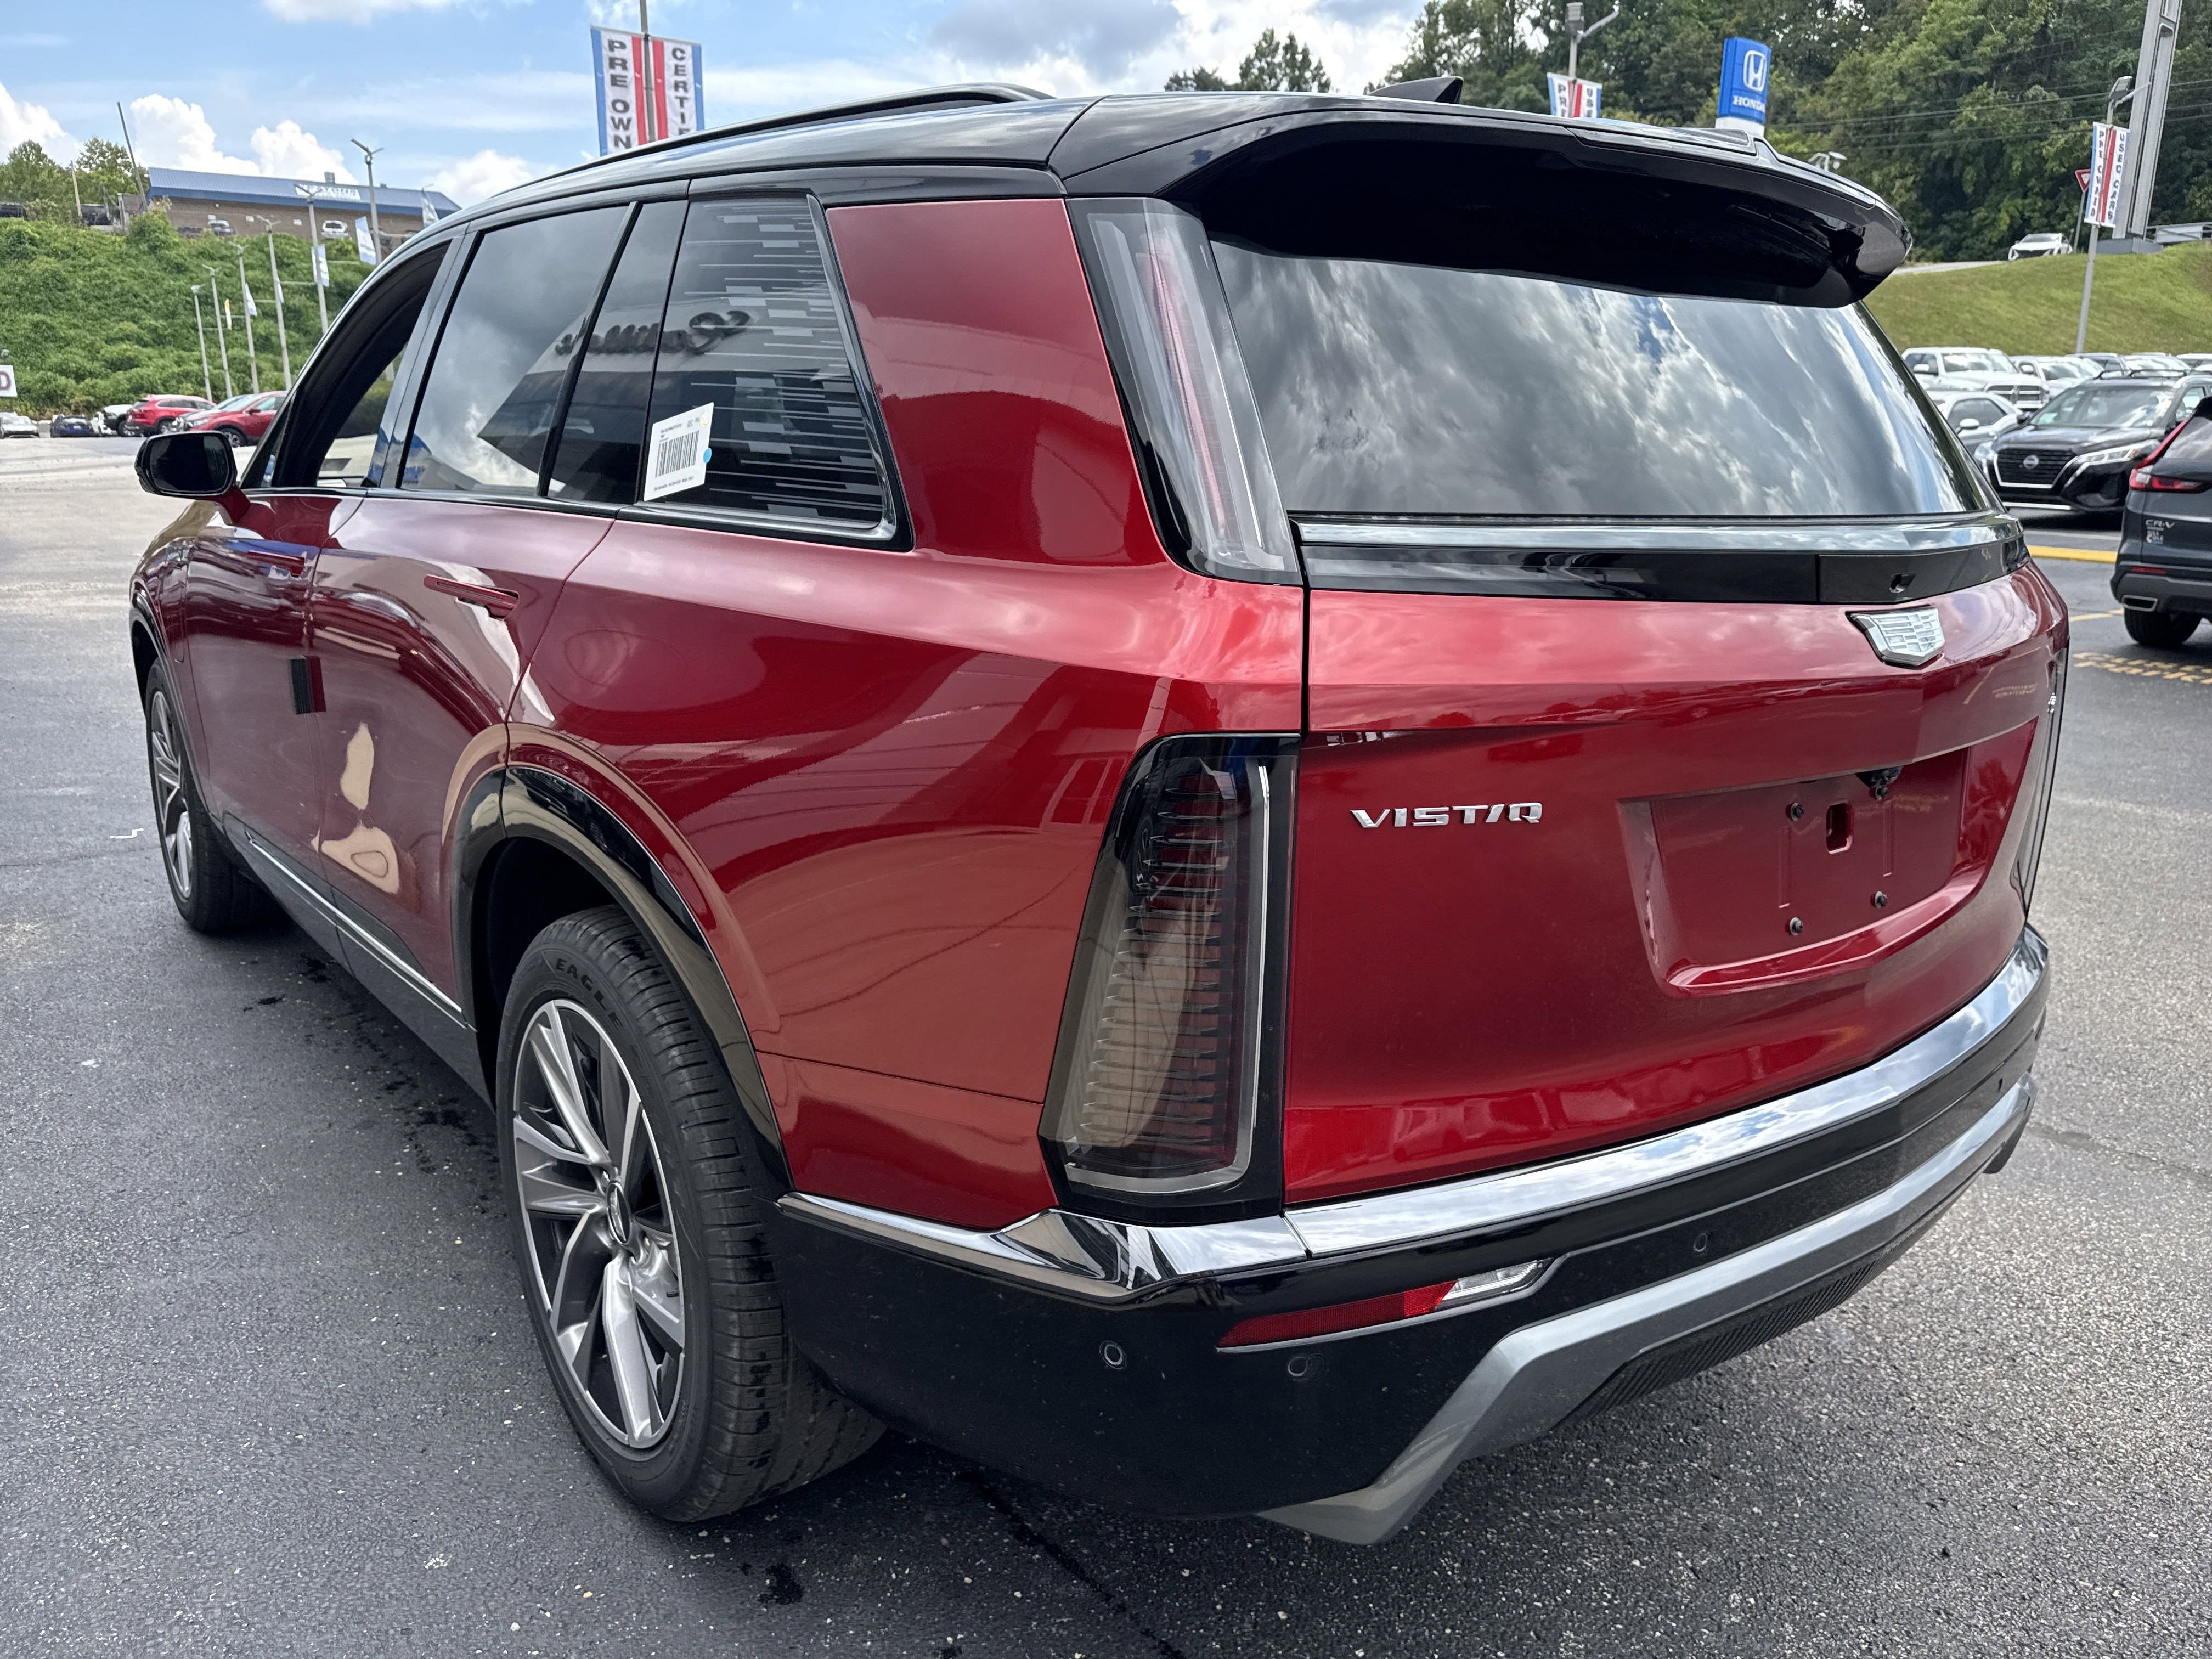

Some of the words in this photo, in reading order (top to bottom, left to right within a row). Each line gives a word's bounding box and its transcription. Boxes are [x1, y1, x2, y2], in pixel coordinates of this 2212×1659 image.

[608, 40, 628, 88] PRE
[2116, 133, 2125, 174] USED
[2108, 180, 2119, 220] CARS
[1349, 802, 1543, 828] VISTIQ
[555, 958, 623, 1030] EAGLE
